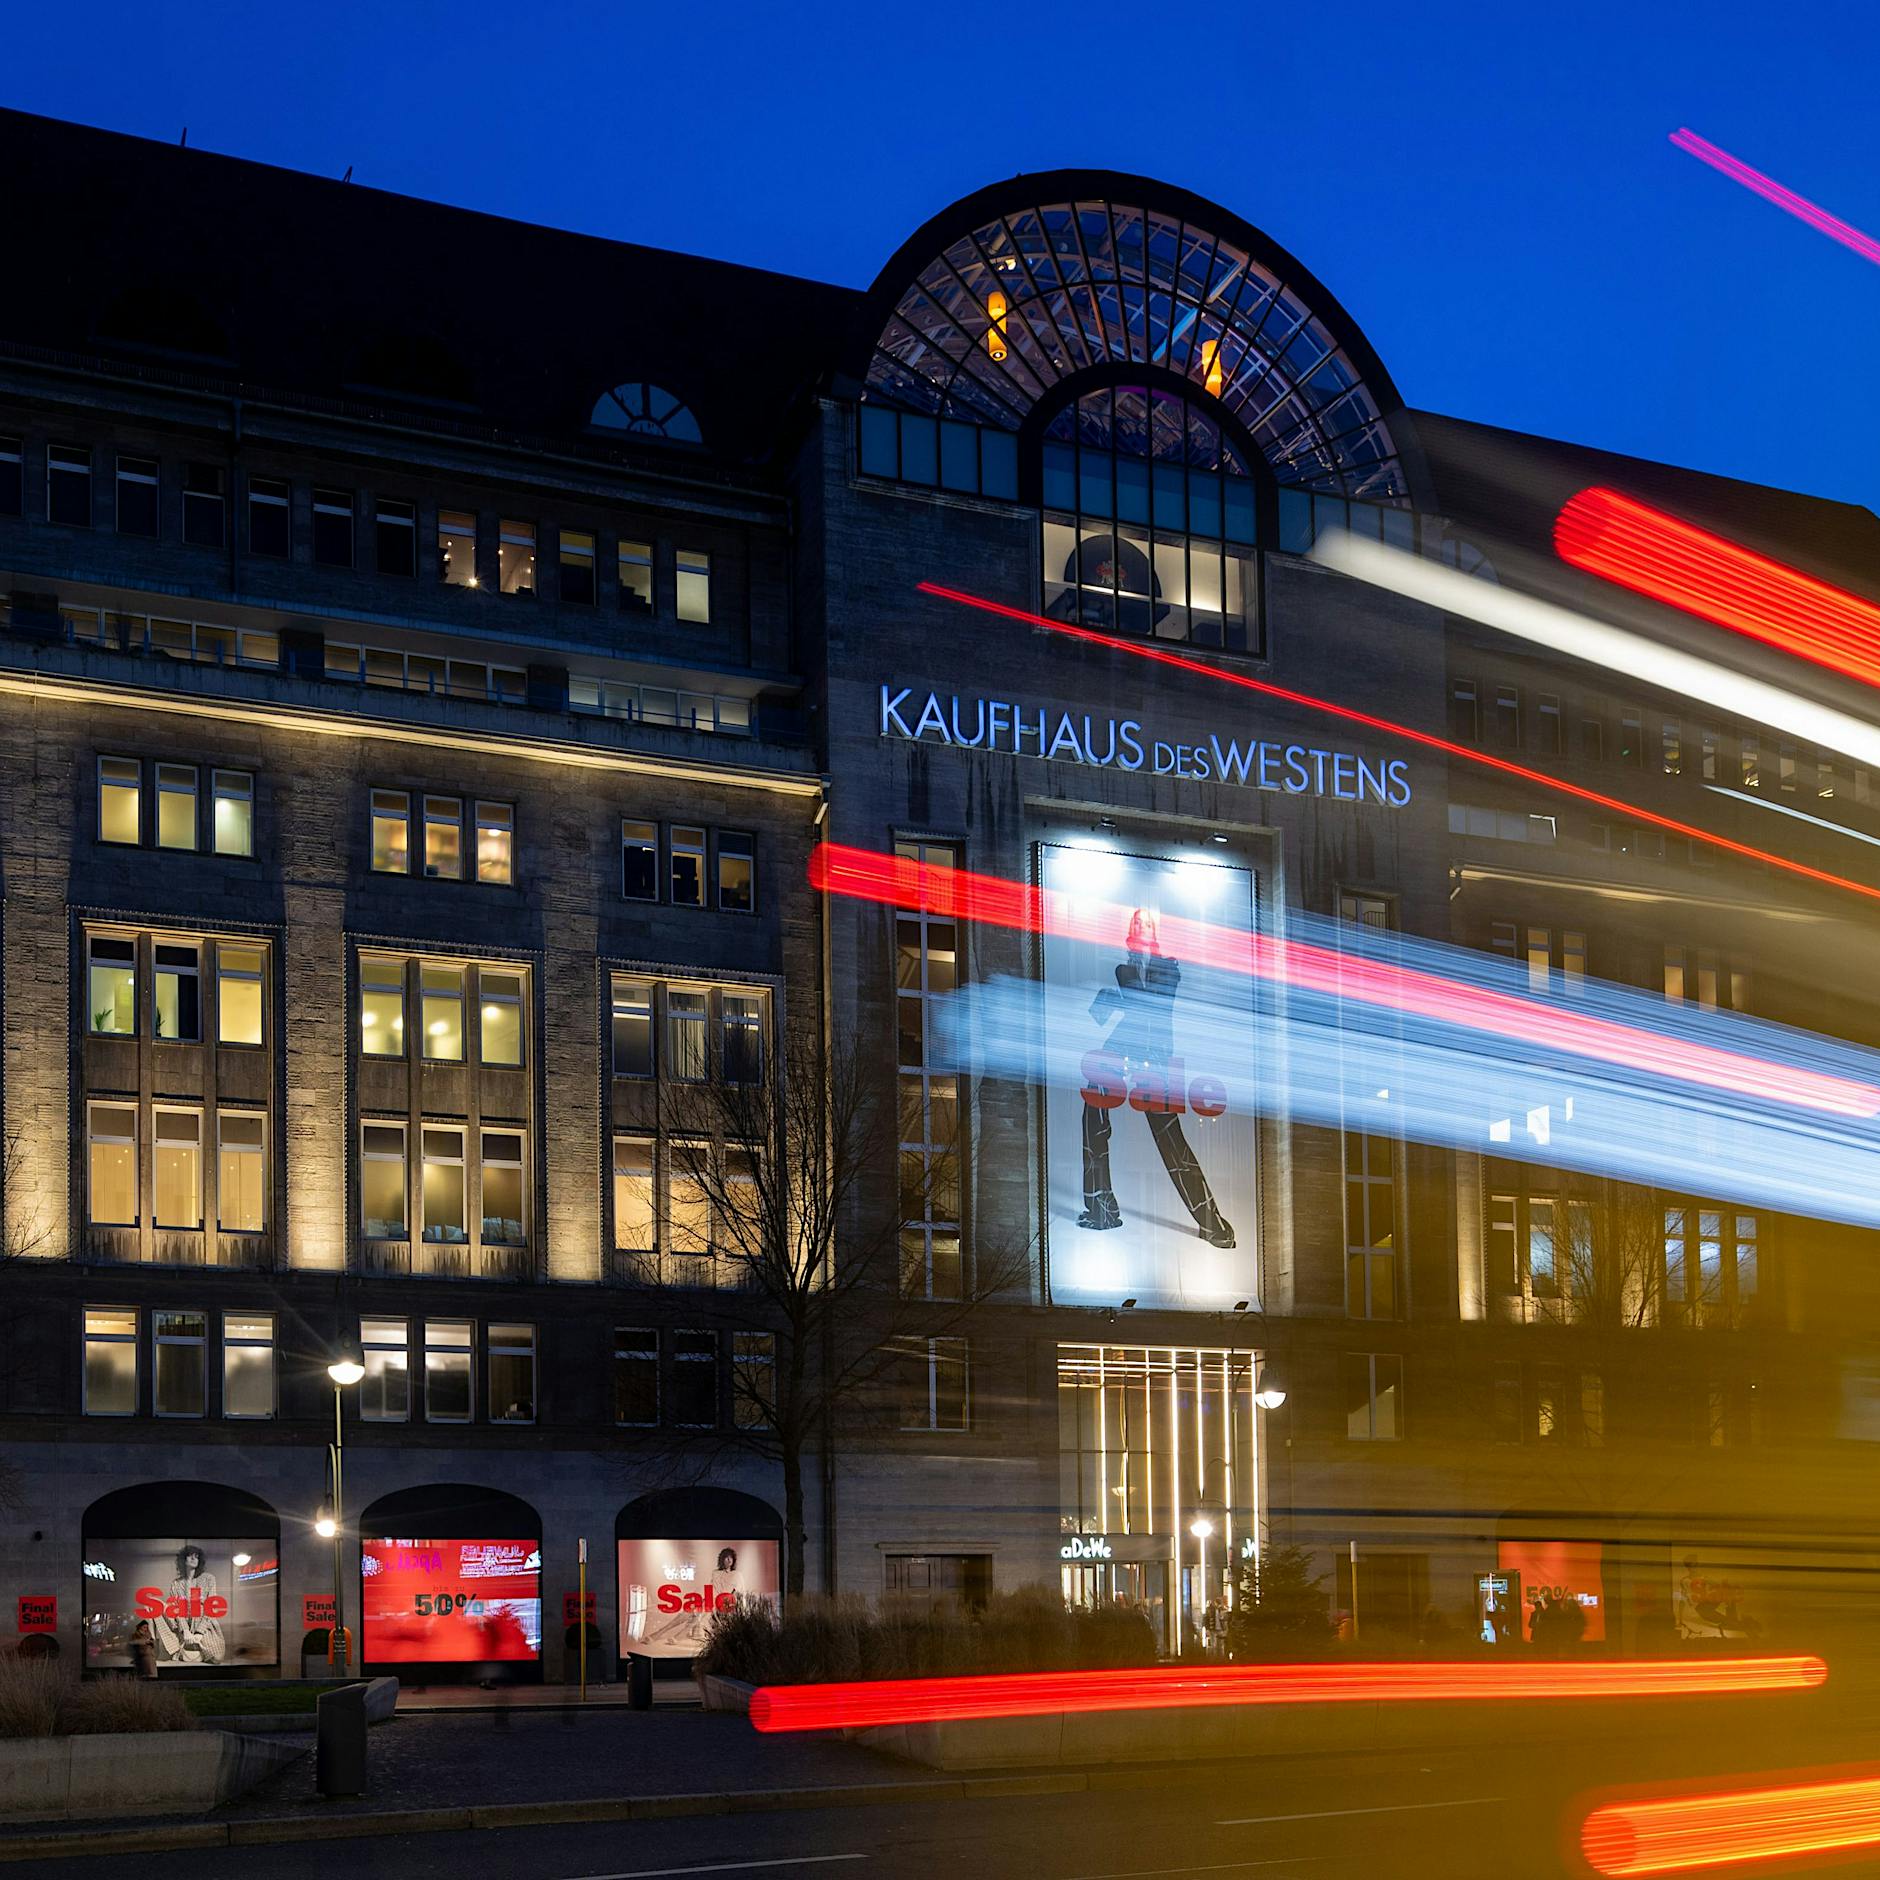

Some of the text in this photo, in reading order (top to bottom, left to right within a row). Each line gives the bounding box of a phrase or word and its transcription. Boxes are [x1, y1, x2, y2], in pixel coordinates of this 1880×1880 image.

[880, 684, 1412, 807] KAUFHAUS DES WESTENS
[1080, 1050, 1228, 1117] Sale
[22, 1603, 54, 1613] Final
[133, 1586, 228, 1619] Sale
[415, 1593, 485, 1616] 50%
[657, 1584, 736, 1614] Sale
[22, 1613, 53, 1624] Sale
[306, 1611, 336, 1622] Sale
[566, 1608, 593, 1619] Sae
